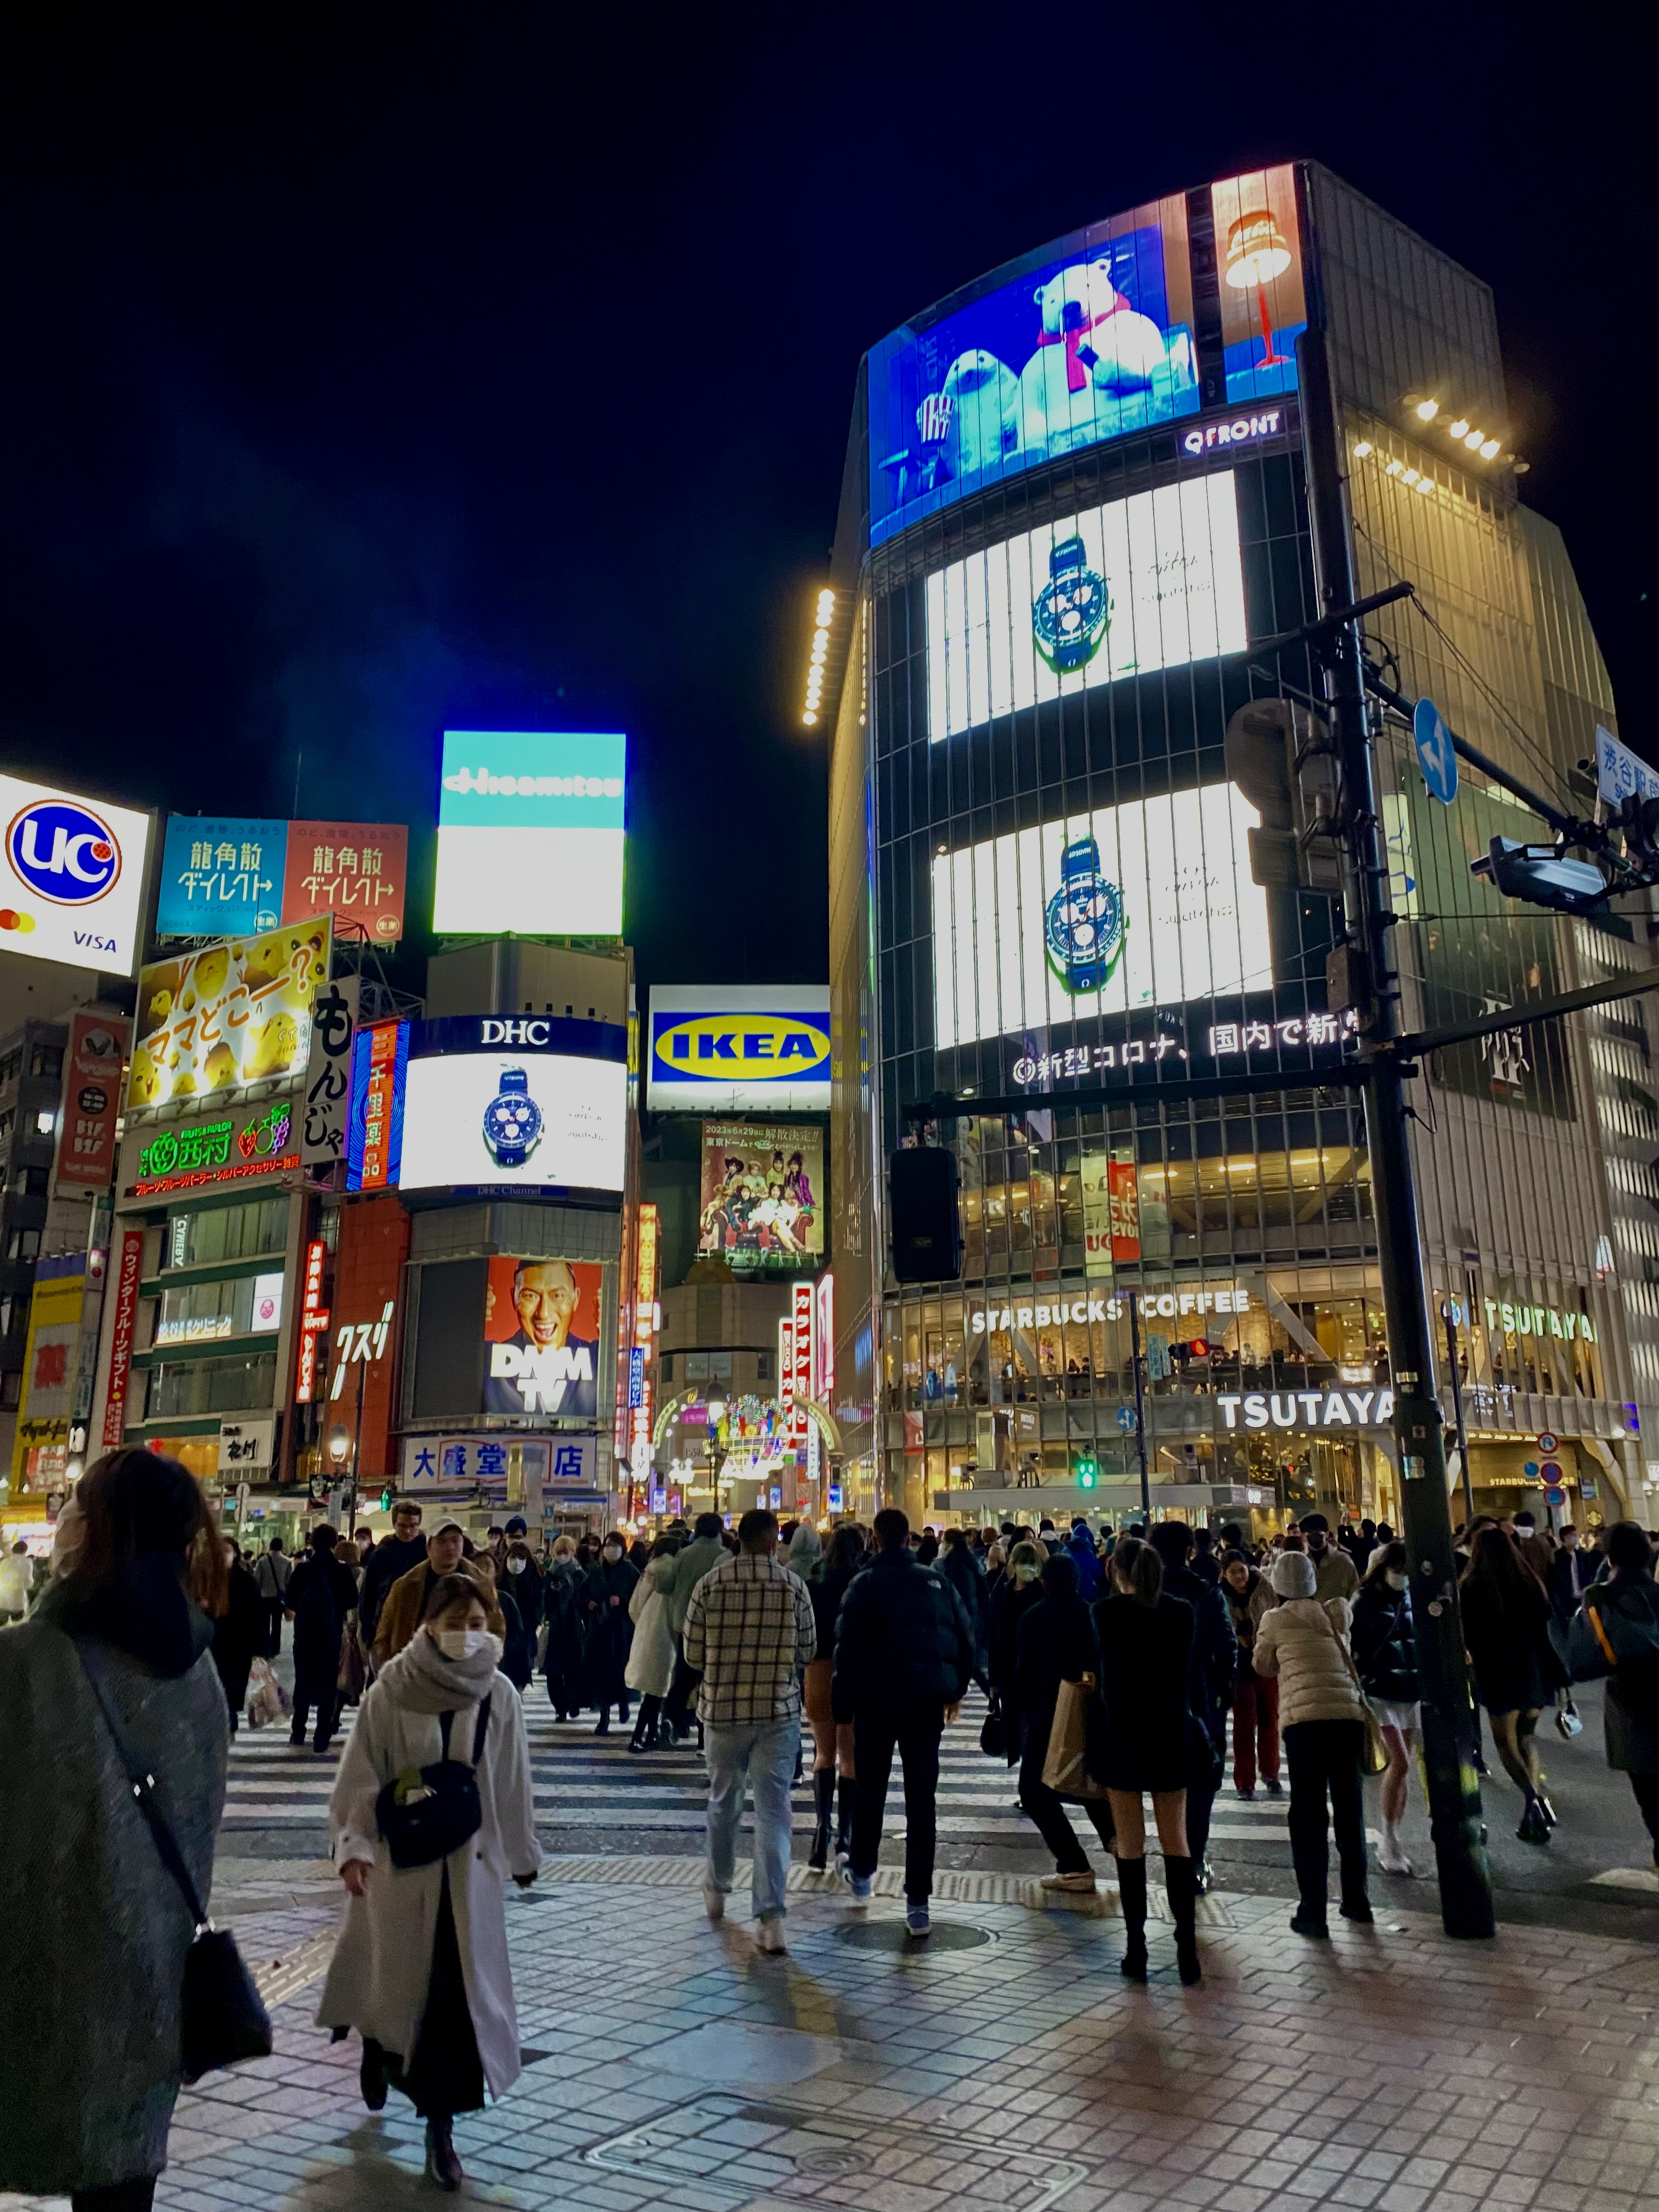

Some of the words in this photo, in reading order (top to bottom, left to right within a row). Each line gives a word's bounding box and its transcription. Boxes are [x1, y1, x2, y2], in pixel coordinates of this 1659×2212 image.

[1184, 413, 1280, 454] QFRONT
[21, 819, 108, 883] UC
[190, 841, 262, 871] 龍角散
[313, 845, 383, 876] 龍角散
[178, 872, 273, 901] ダイレクト
[301, 876, 394, 906] ダイレクト
[73, 930, 116, 953] VISA
[481, 1019, 551, 1045] DHC
[672, 1033, 819, 1059] IKEA
[304, 984, 353, 1155] もんじゃ
[362, 1032, 391, 1177] 三千里薬品
[178, 1132, 231, 1170] 西村
[706, 1137, 753, 1148] 東京ドームで
[477, 1186, 500, 1195] DHC
[501, 1186, 541, 1195] Channel
[174, 1219, 187, 1267] CAMERA
[114, 1254, 137, 1390] ウィンターフルーツギフト
[972, 1298, 1122, 1334] STARBUCKS
[1139, 1290, 1250, 1317] COFFEE
[1485, 1301, 1594, 1342] TSUTAYA
[795, 1295, 811, 1370] カラオケ
[490, 1344, 593, 1381] DMM
[517, 1379, 567, 1415] TV
[1217, 1391, 1395, 1427] TSUTAYA
[413, 1444, 584, 1479] 大盛堂店
[1489, 1478, 1541, 1486] STARBU
